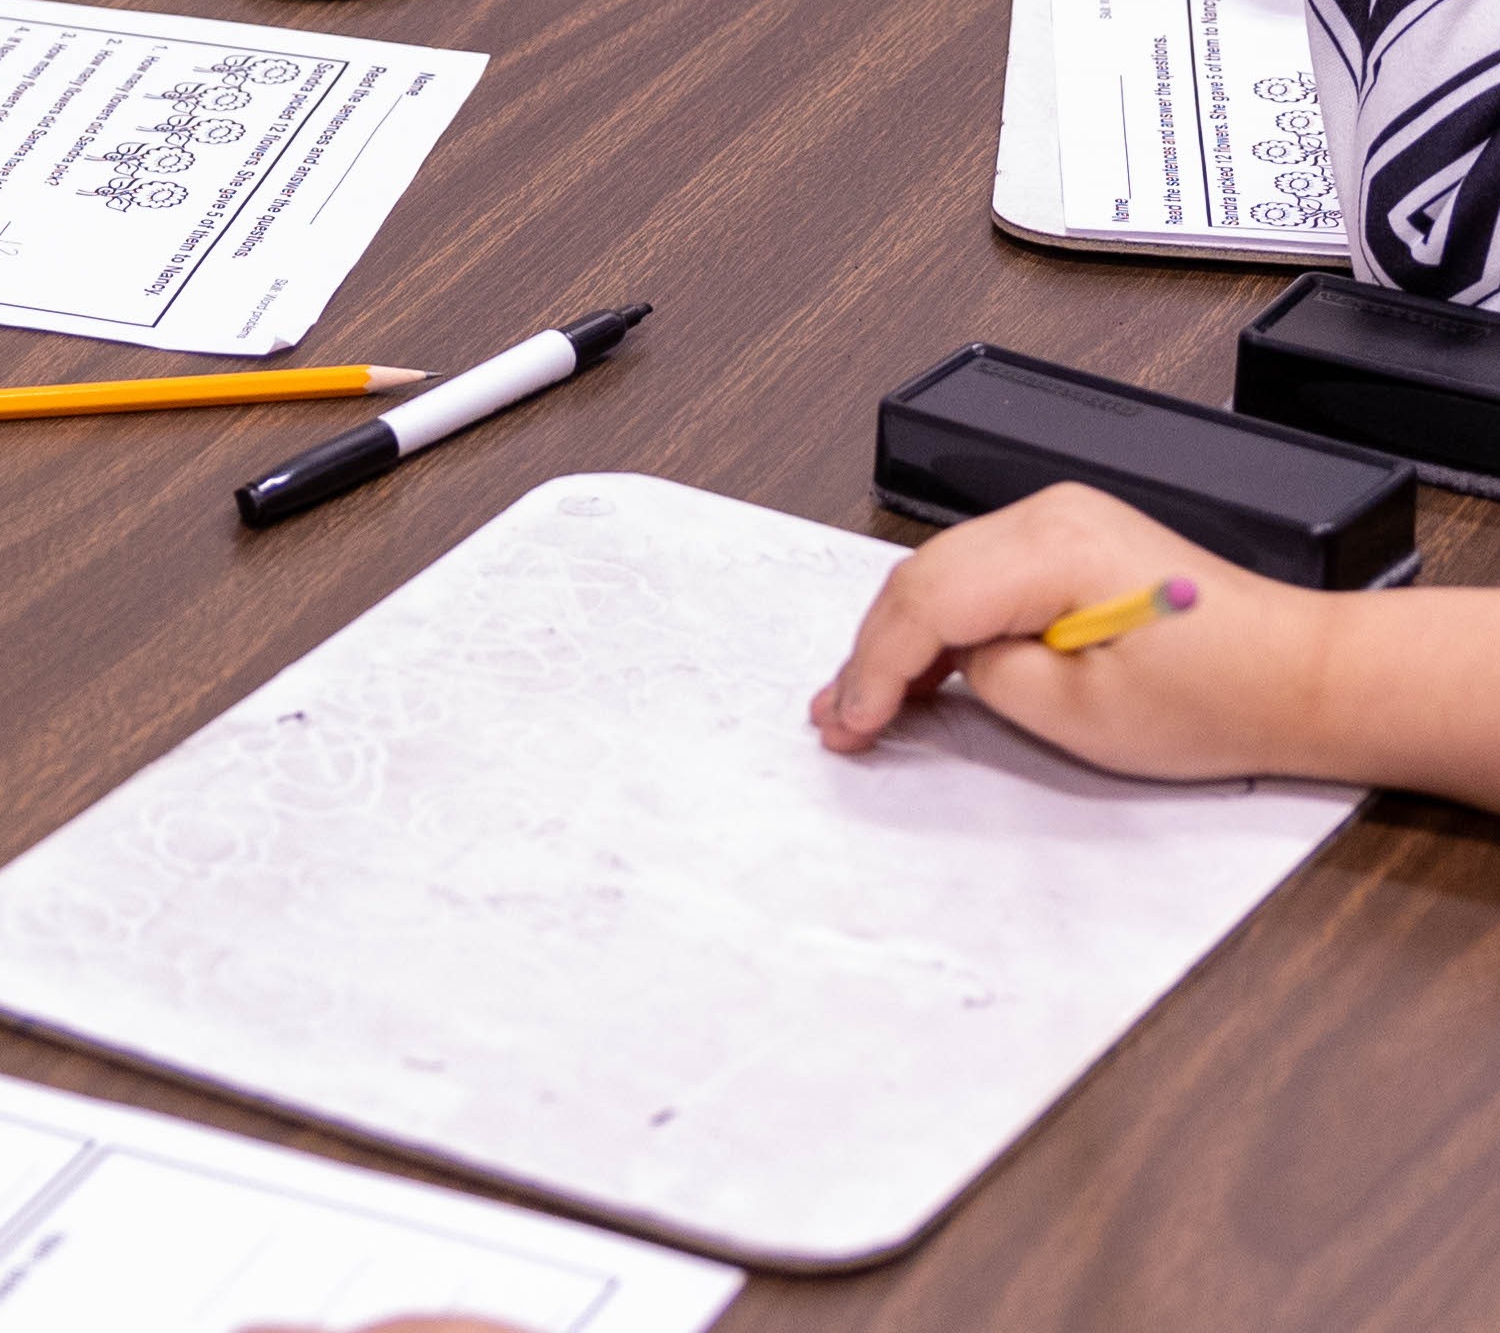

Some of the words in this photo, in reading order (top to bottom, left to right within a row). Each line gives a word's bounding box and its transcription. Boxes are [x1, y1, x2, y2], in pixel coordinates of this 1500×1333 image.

[1203, 26, 1218, 35] to
[44, 43, 67, 60] How
[90, 49, 113, 66] How
[1151, 35, 1172, 79] questions.
[1205, 38, 1220, 60] them
[22, 60, 49, 80] many
[136, 55, 160, 72] How
[1204, 63, 1221, 72] of
[69, 67, 95, 86] many
[115, 73, 142, 92] many
[299, 62, 334, 92] Sandra
[358, 65, 387, 88] Read
[405, 72, 435, 96] Name
[1, 80, 35, 108] flowers
[348, 89, 369, 102] the
[1154, 82, 1171, 95] the
[1210, 81, 1229, 101] gave
[48, 87, 81, 114] flowers
[95, 93, 128, 120] flowers
[278, 93, 307, 120] picked
[1209, 103, 1227, 119] She
[37, 115, 56, 128] did
[1158, 98, 1173, 127] answer
[84, 121, 103, 134] did
[316, 104, 355, 144] sentences
[13, 129, 47, 156] Sandra
[1158, 129, 1175, 144] and
[1213, 122, 1230, 152] flowers.
[61, 135, 94, 162] Sandra
[243, 134, 281, 167] flowers.
[302, 147, 324, 165] and
[1214, 154, 1232, 163] 12
[44, 163, 68, 186] pick?
[1162, 146, 1179, 186] sentences
[229, 169, 255, 186] She
[280, 165, 310, 197] answer
[1216, 166, 1239, 194] picked
[211, 187, 236, 209] gave
[267, 198, 290, 212] the
[1163, 188, 1181, 202] the
[1112, 198, 1129, 222] Name
[1164, 204, 1182, 224] Read
[1220, 196, 1239, 225] Sandra
[179, 229, 209, 251] them
[232, 214, 275, 258] questions.
[144, 265, 183, 295] Nancy.
